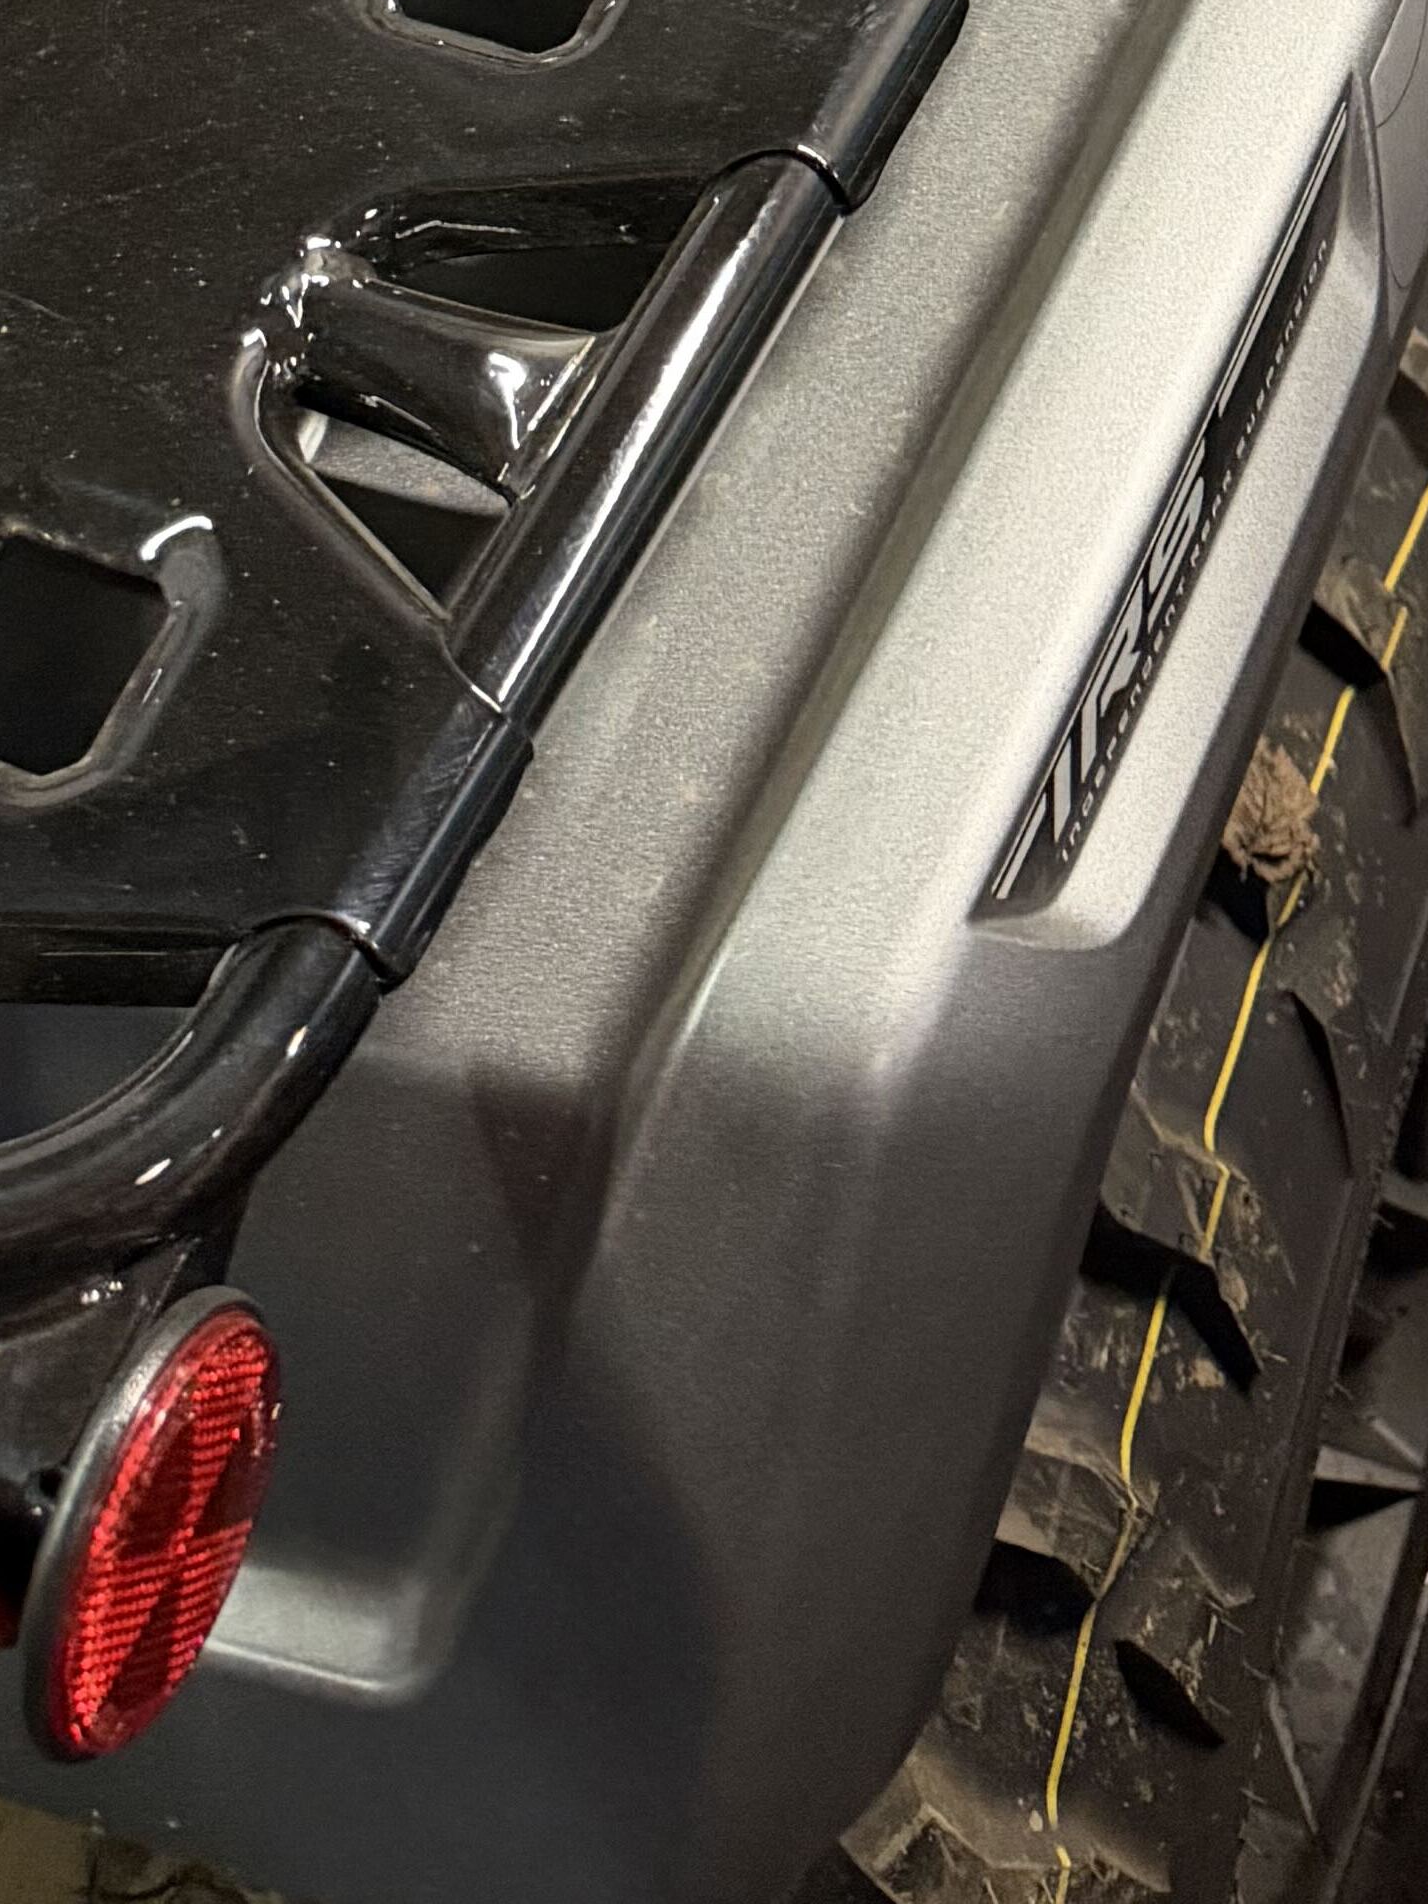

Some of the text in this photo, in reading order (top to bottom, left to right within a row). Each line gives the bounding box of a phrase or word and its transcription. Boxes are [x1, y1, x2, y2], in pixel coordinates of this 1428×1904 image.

[1053, 436, 1204, 843] IRS
[1060, 238, 1327, 863] INDEPENDENT REAR SUSPENSION
